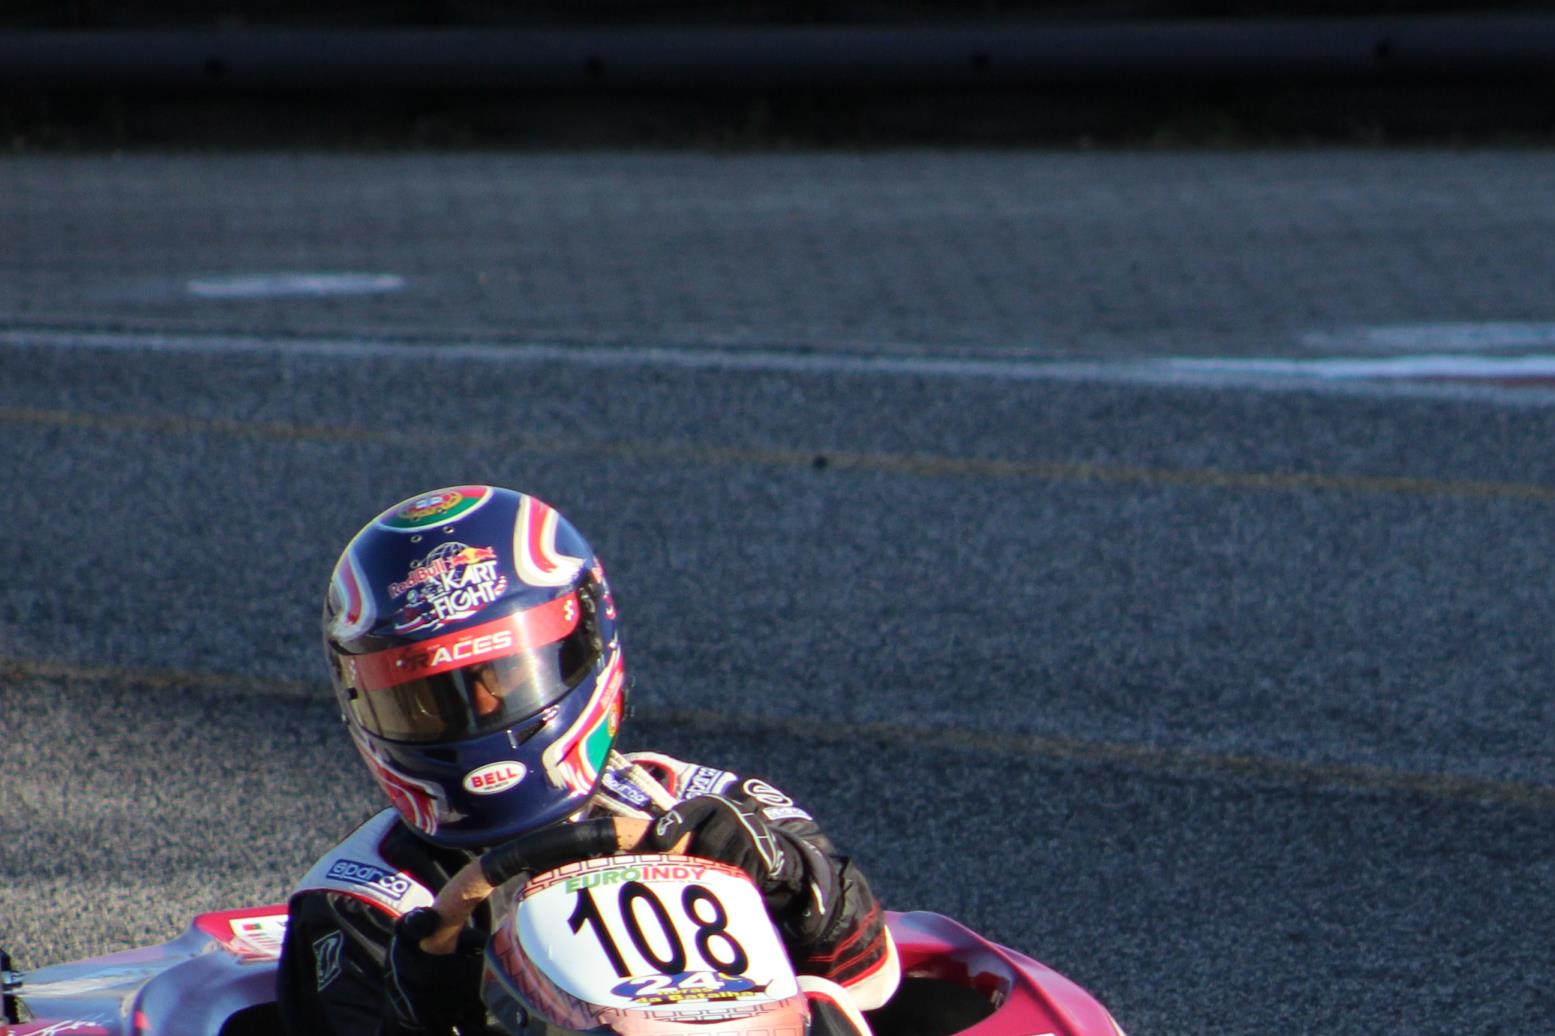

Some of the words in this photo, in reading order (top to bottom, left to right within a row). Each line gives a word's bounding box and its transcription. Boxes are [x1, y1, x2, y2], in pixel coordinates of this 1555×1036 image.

[440, 560, 498, 592] KART
[433, 580, 497, 619] FIGHT
[471, 767, 520, 788] BELL
[332, 861, 410, 894] sparco
[566, 866, 706, 894] EUROINDY
[567, 880, 750, 979] 108
[630, 971, 726, 996] 24
